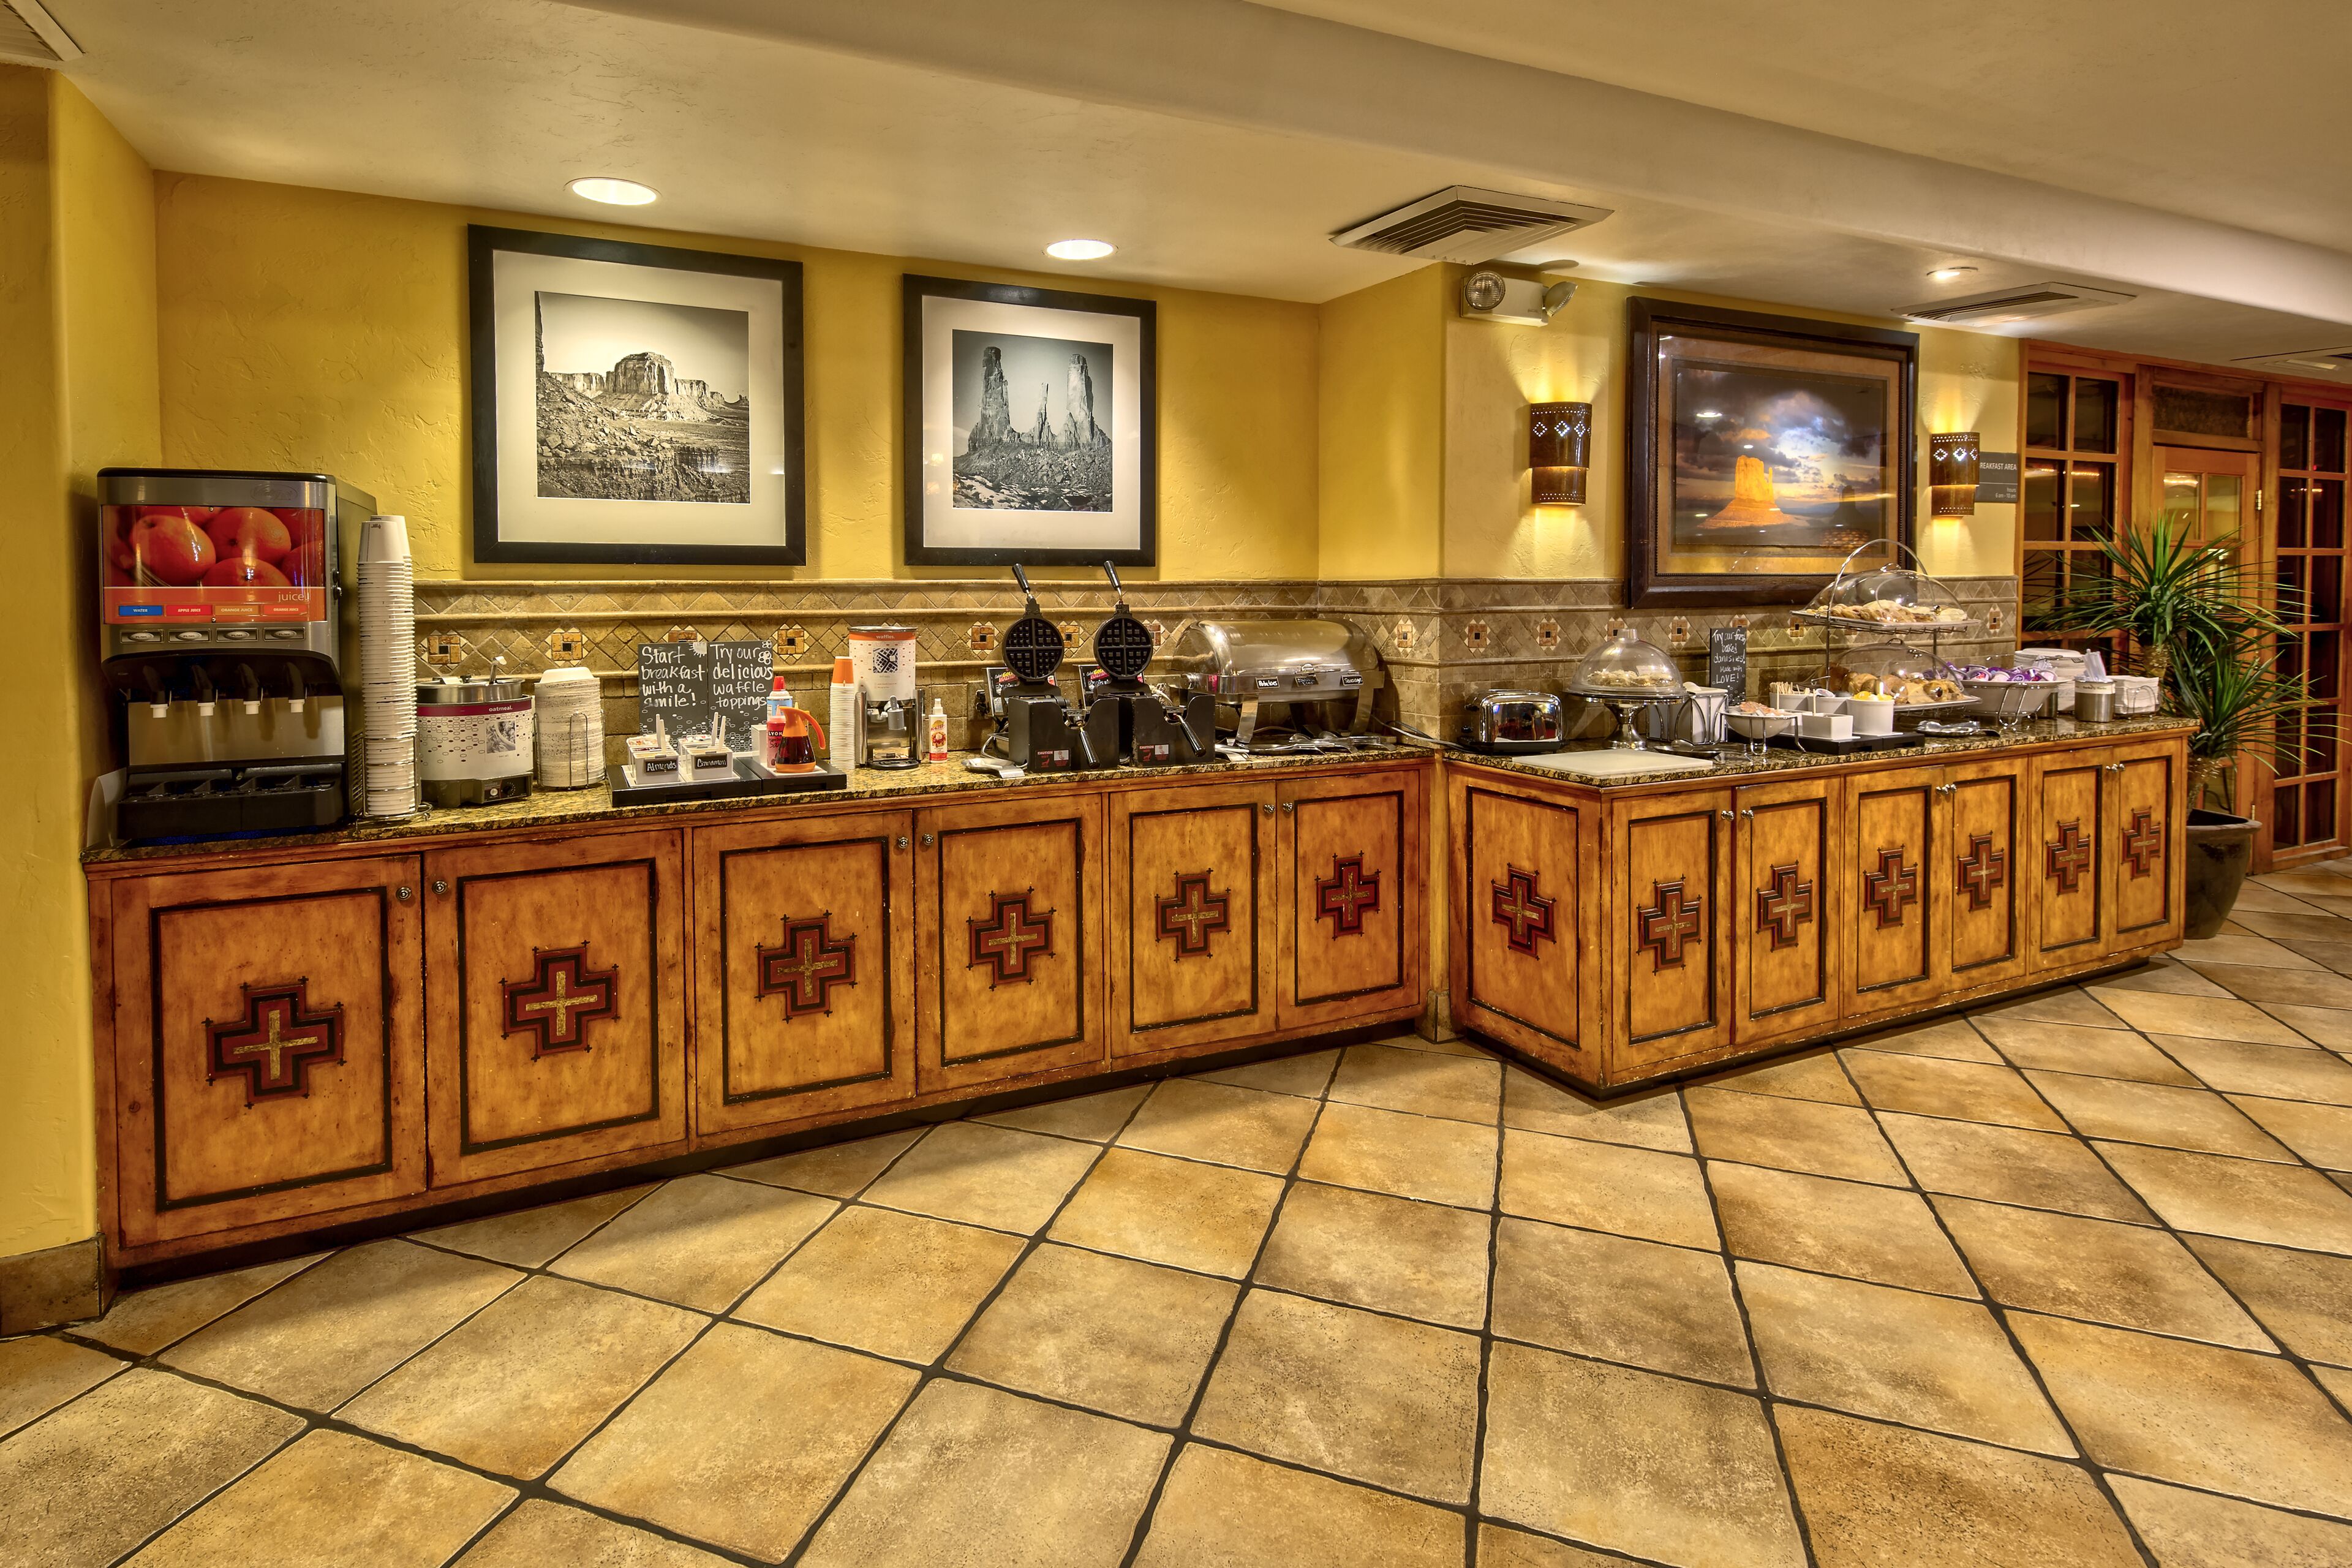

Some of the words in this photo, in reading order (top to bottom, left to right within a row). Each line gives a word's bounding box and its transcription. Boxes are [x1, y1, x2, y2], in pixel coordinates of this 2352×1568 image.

[1712, 630, 1723, 644] Try
[1734, 629, 1746, 645] fresh
[642, 646, 685, 665] Start
[709, 644, 733, 664] Try
[737, 647, 760, 660] our
[641, 665, 706, 681] breakfast
[713, 662, 774, 680] delicious
[1716, 673, 1738, 684] LOVE!
[643, 681, 673, 696] with
[677, 683, 692, 694] a
[713, 681, 766, 695] waffle
[716, 696, 767, 710] toppings
[697, 758, 726, 767] Cinnamon
